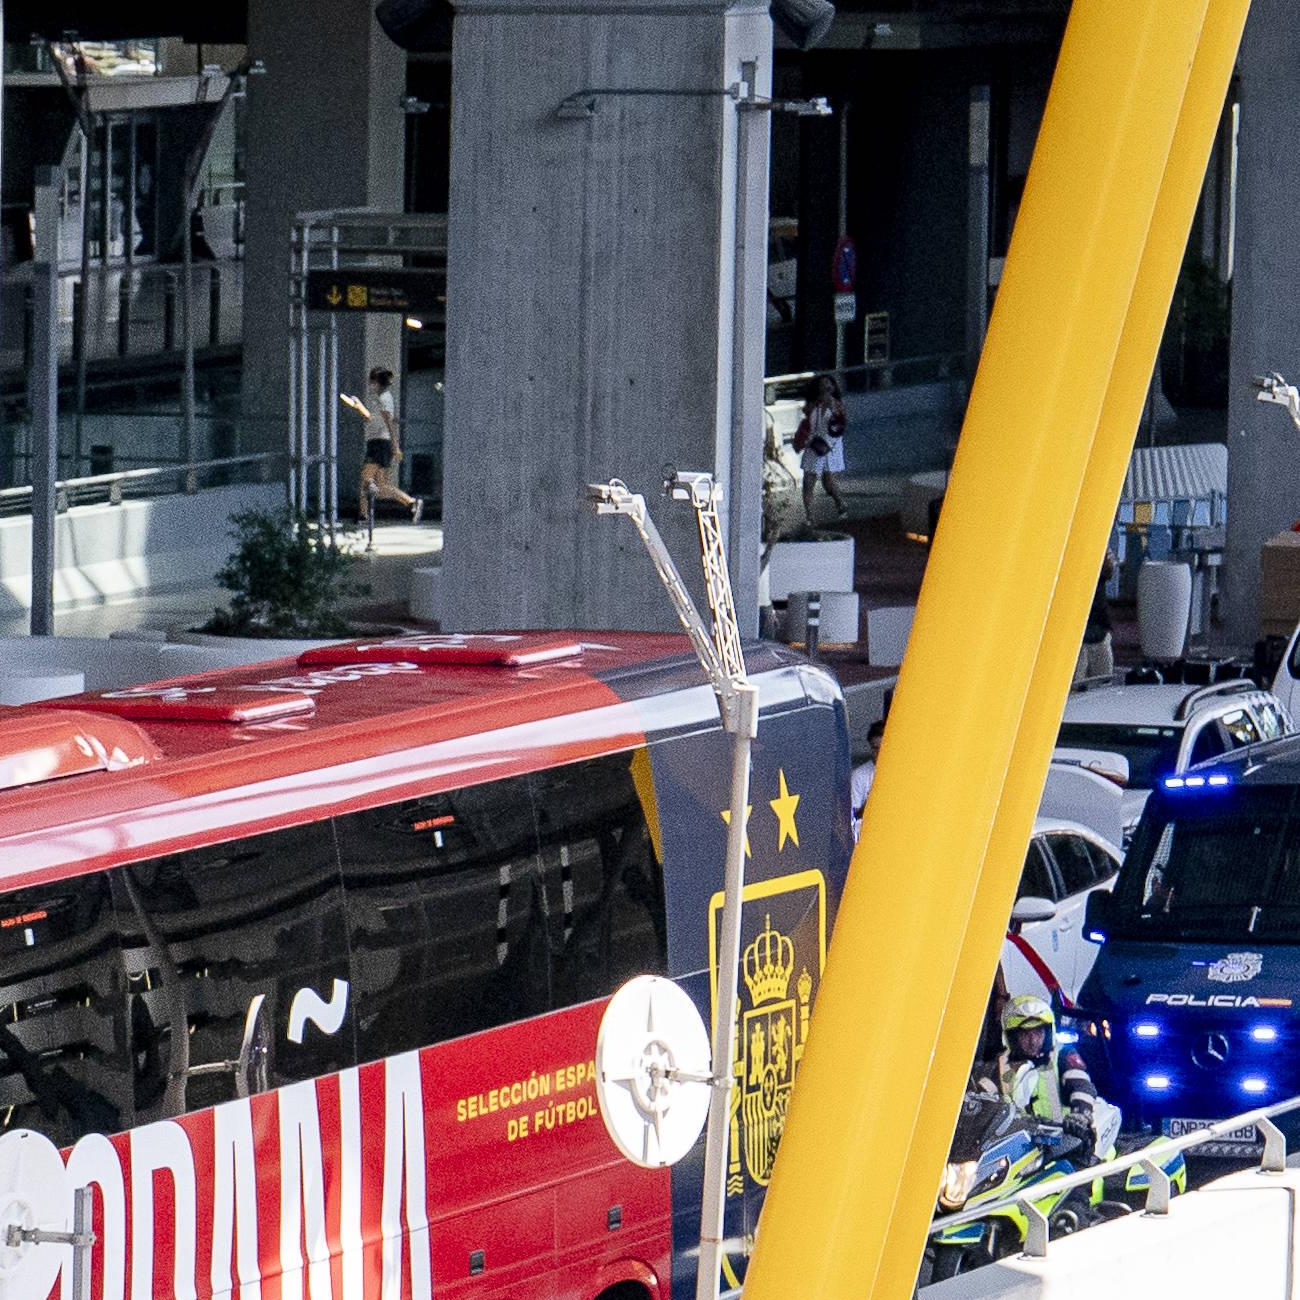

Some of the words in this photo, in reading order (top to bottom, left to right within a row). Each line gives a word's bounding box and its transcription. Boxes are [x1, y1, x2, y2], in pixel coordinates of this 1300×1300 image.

[1146, 993, 1261, 1008] POLICIA
[457, 1071, 551, 1122] SELECCIÓN
[556, 1060, 597, 1092] ESPA
[507, 1116, 529, 1142] DE
[535, 1096, 598, 1133] FÚTBOL
